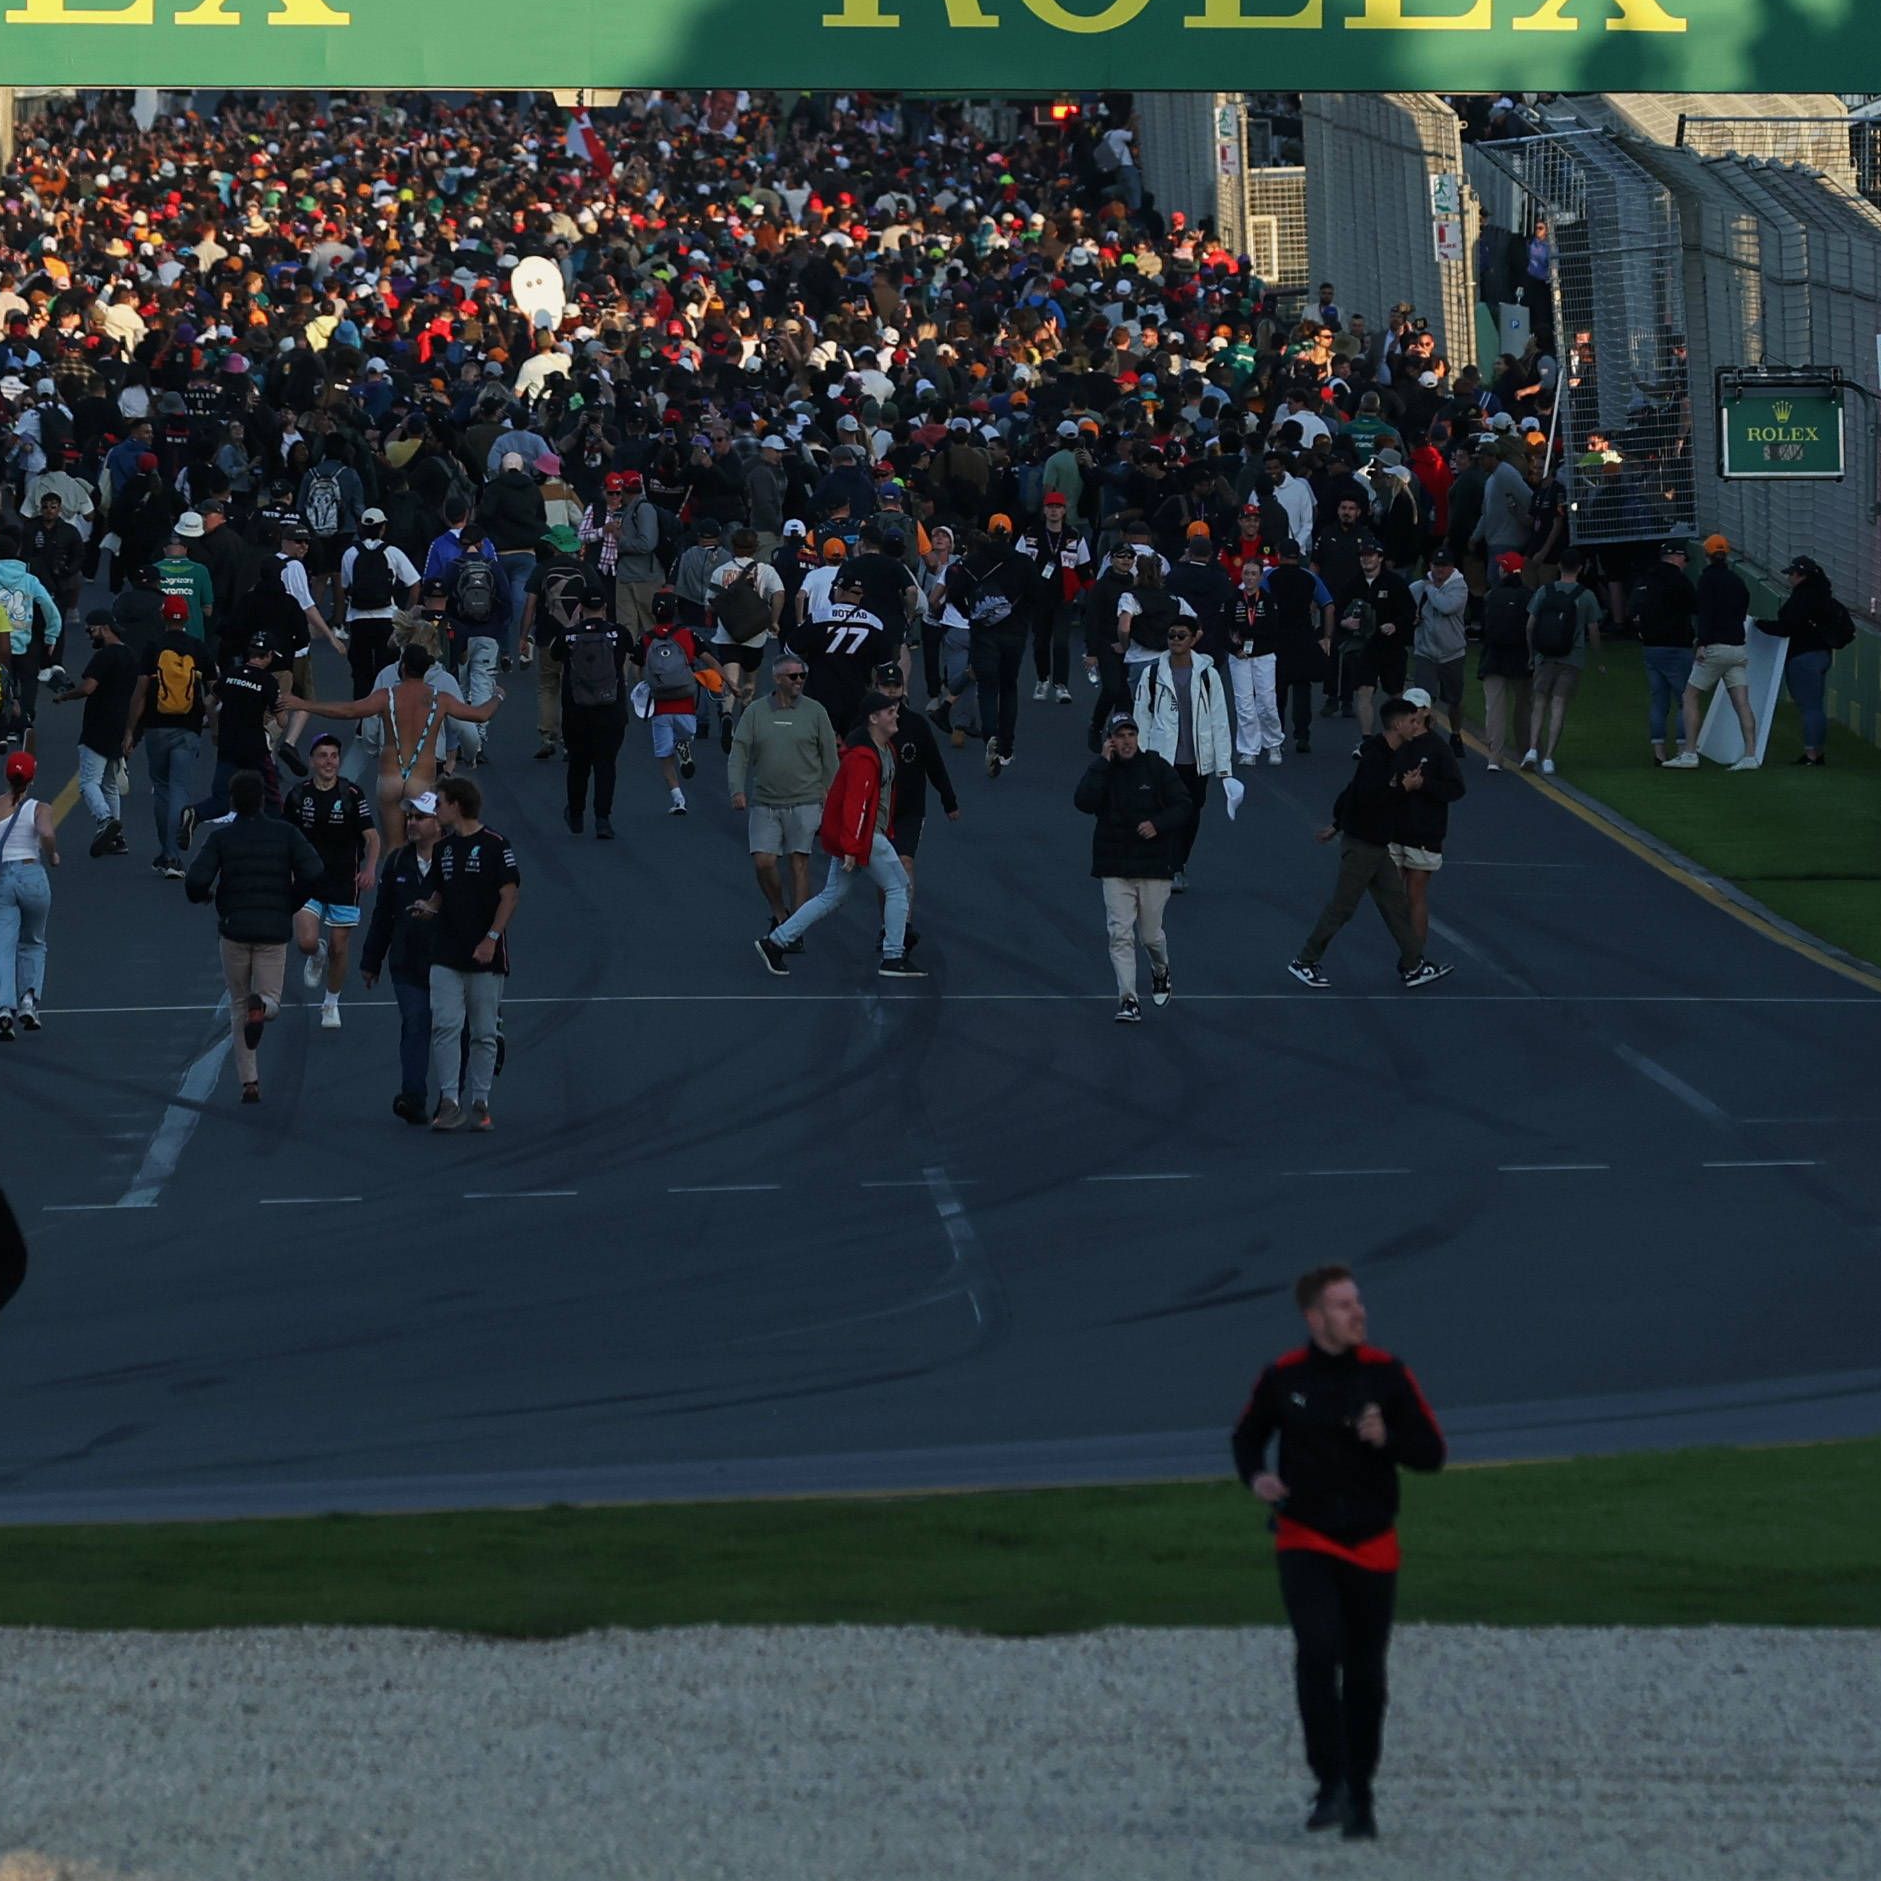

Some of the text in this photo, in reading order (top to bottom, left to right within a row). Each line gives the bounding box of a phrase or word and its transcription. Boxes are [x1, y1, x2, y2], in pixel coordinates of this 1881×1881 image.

[1747, 426, 1820, 442] ROLEX
[825, 626, 871, 655] 77
[225, 677, 263, 692] PETRONAS
